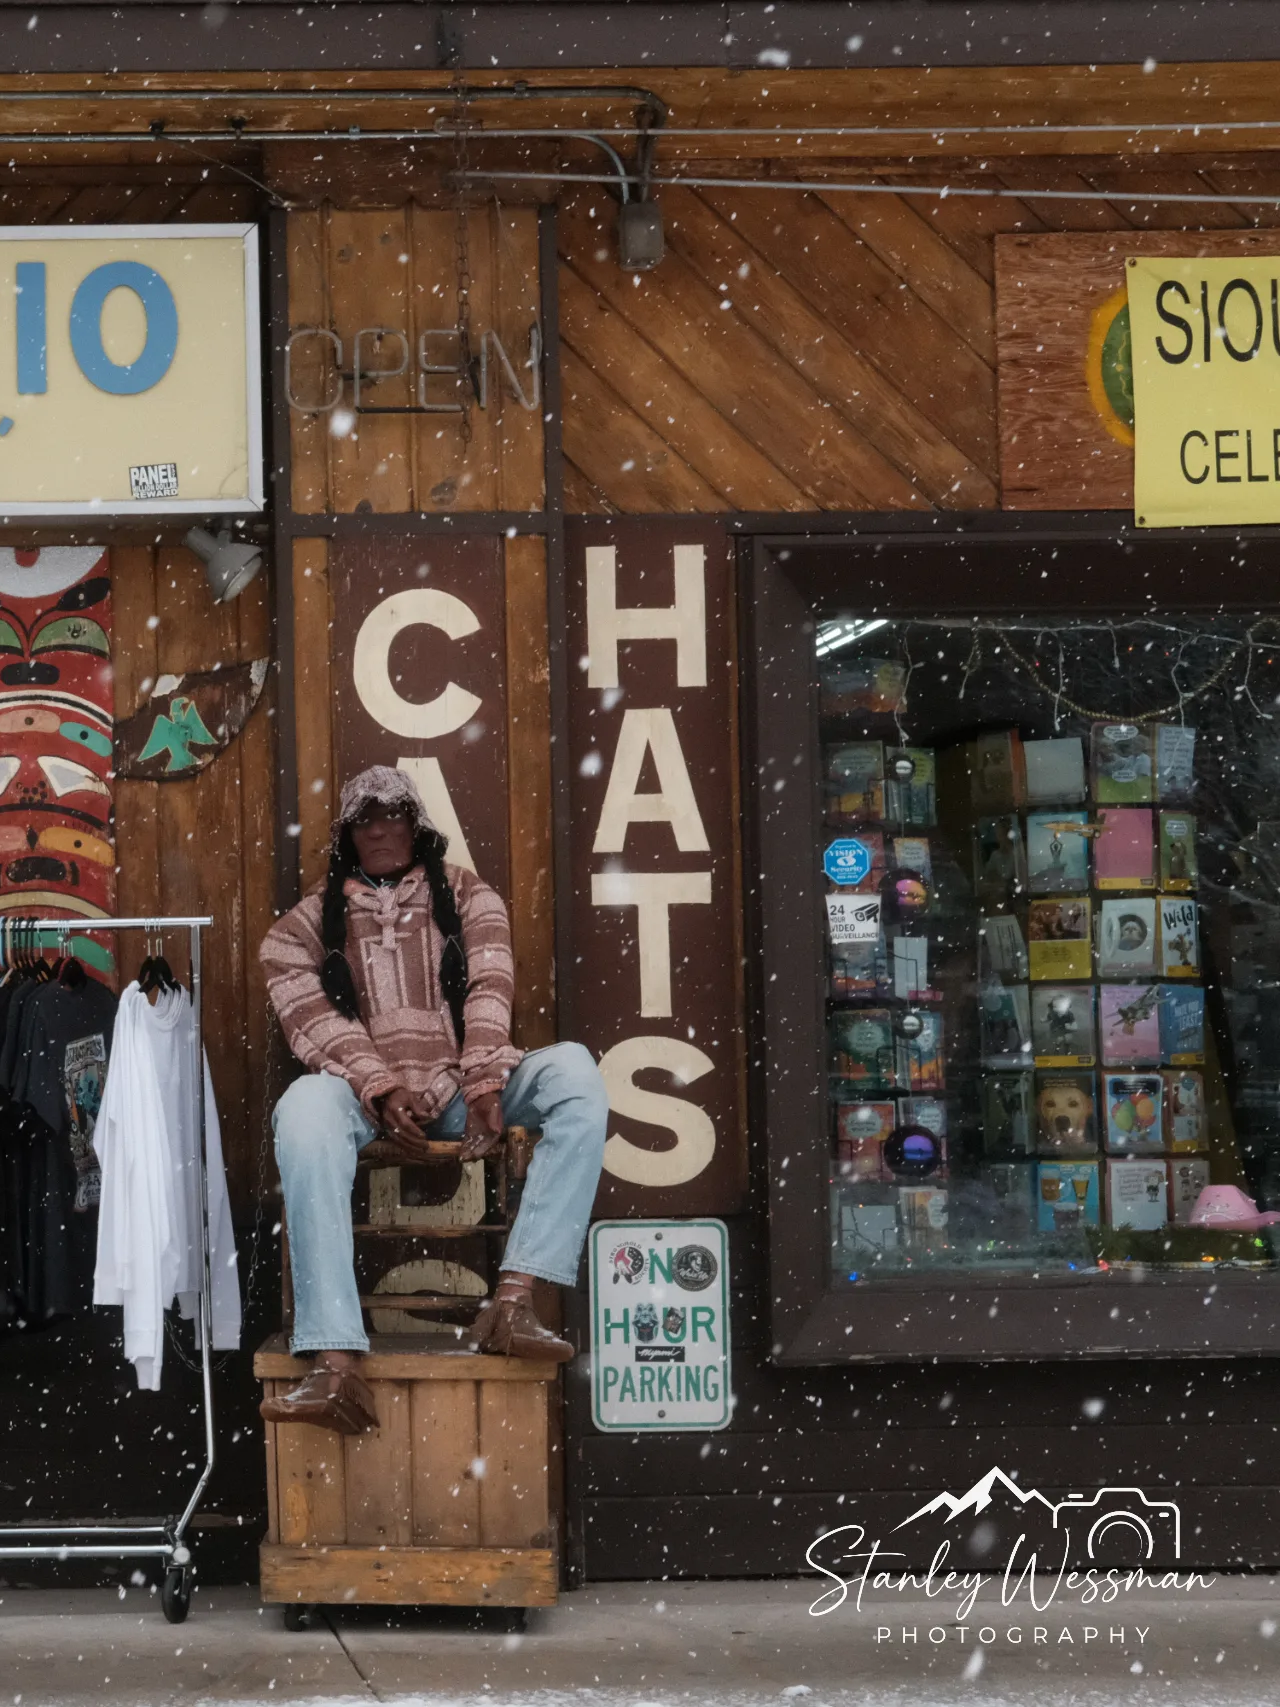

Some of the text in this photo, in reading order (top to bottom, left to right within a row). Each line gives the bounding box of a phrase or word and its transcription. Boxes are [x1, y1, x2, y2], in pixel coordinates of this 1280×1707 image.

[1154, 278, 1280, 365] SIO
[284, 327, 543, 412] OPEN
[1179, 428, 1280, 485] CEL
[130, 463, 177, 488] PANEL
[133, 488, 178, 499] REWARD
[586, 544, 717, 1187] HATS
[828, 848, 864, 856] VISION
[830, 904, 845, 916] 24
[1163, 904, 1195, 930] Wild
[831, 924, 856, 932] VIDEO
[603, 1305, 717, 1345] HUR
[603, 1364, 719, 1403] PARKING
